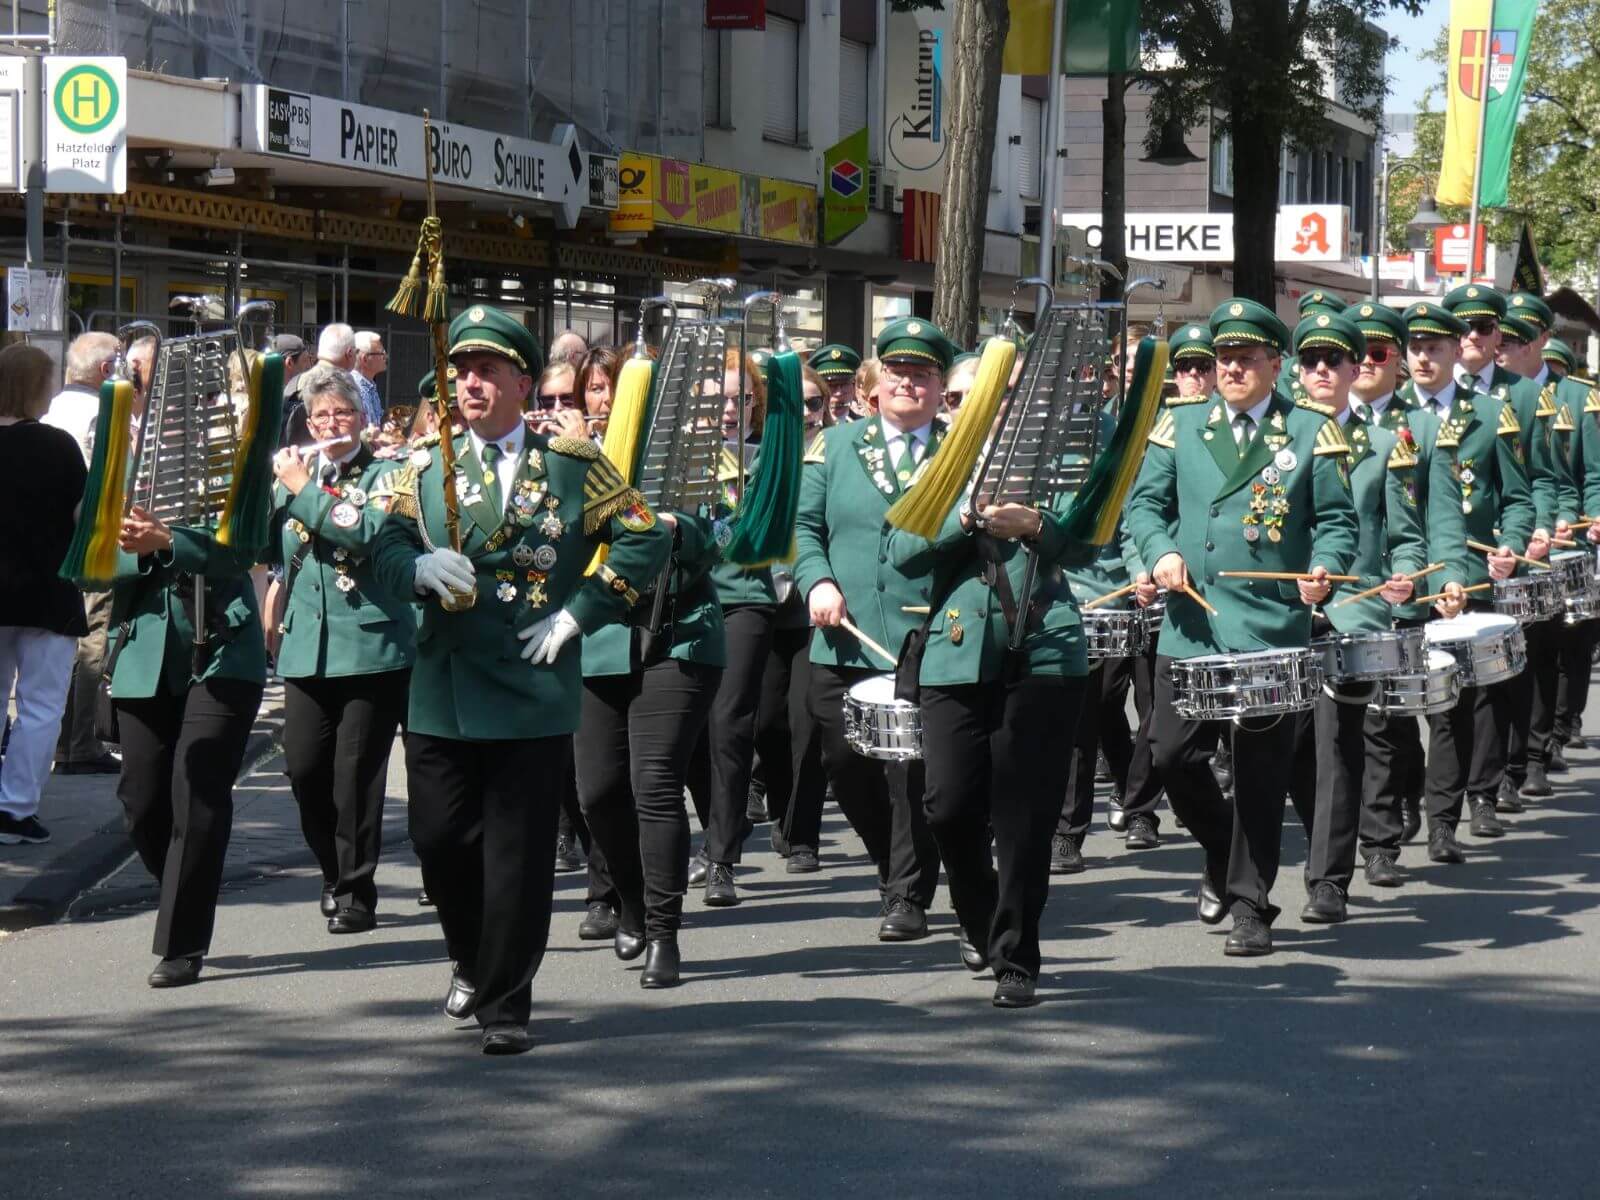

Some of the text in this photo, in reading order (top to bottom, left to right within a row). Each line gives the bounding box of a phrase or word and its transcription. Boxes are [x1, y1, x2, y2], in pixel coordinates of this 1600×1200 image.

[73, 79, 100, 118] H
[903, 29, 939, 140] Kintrup
[56, 142, 117, 153] Hatzfelder
[72, 158, 101, 168] Platz
[494, 137, 545, 194] SCHULE
